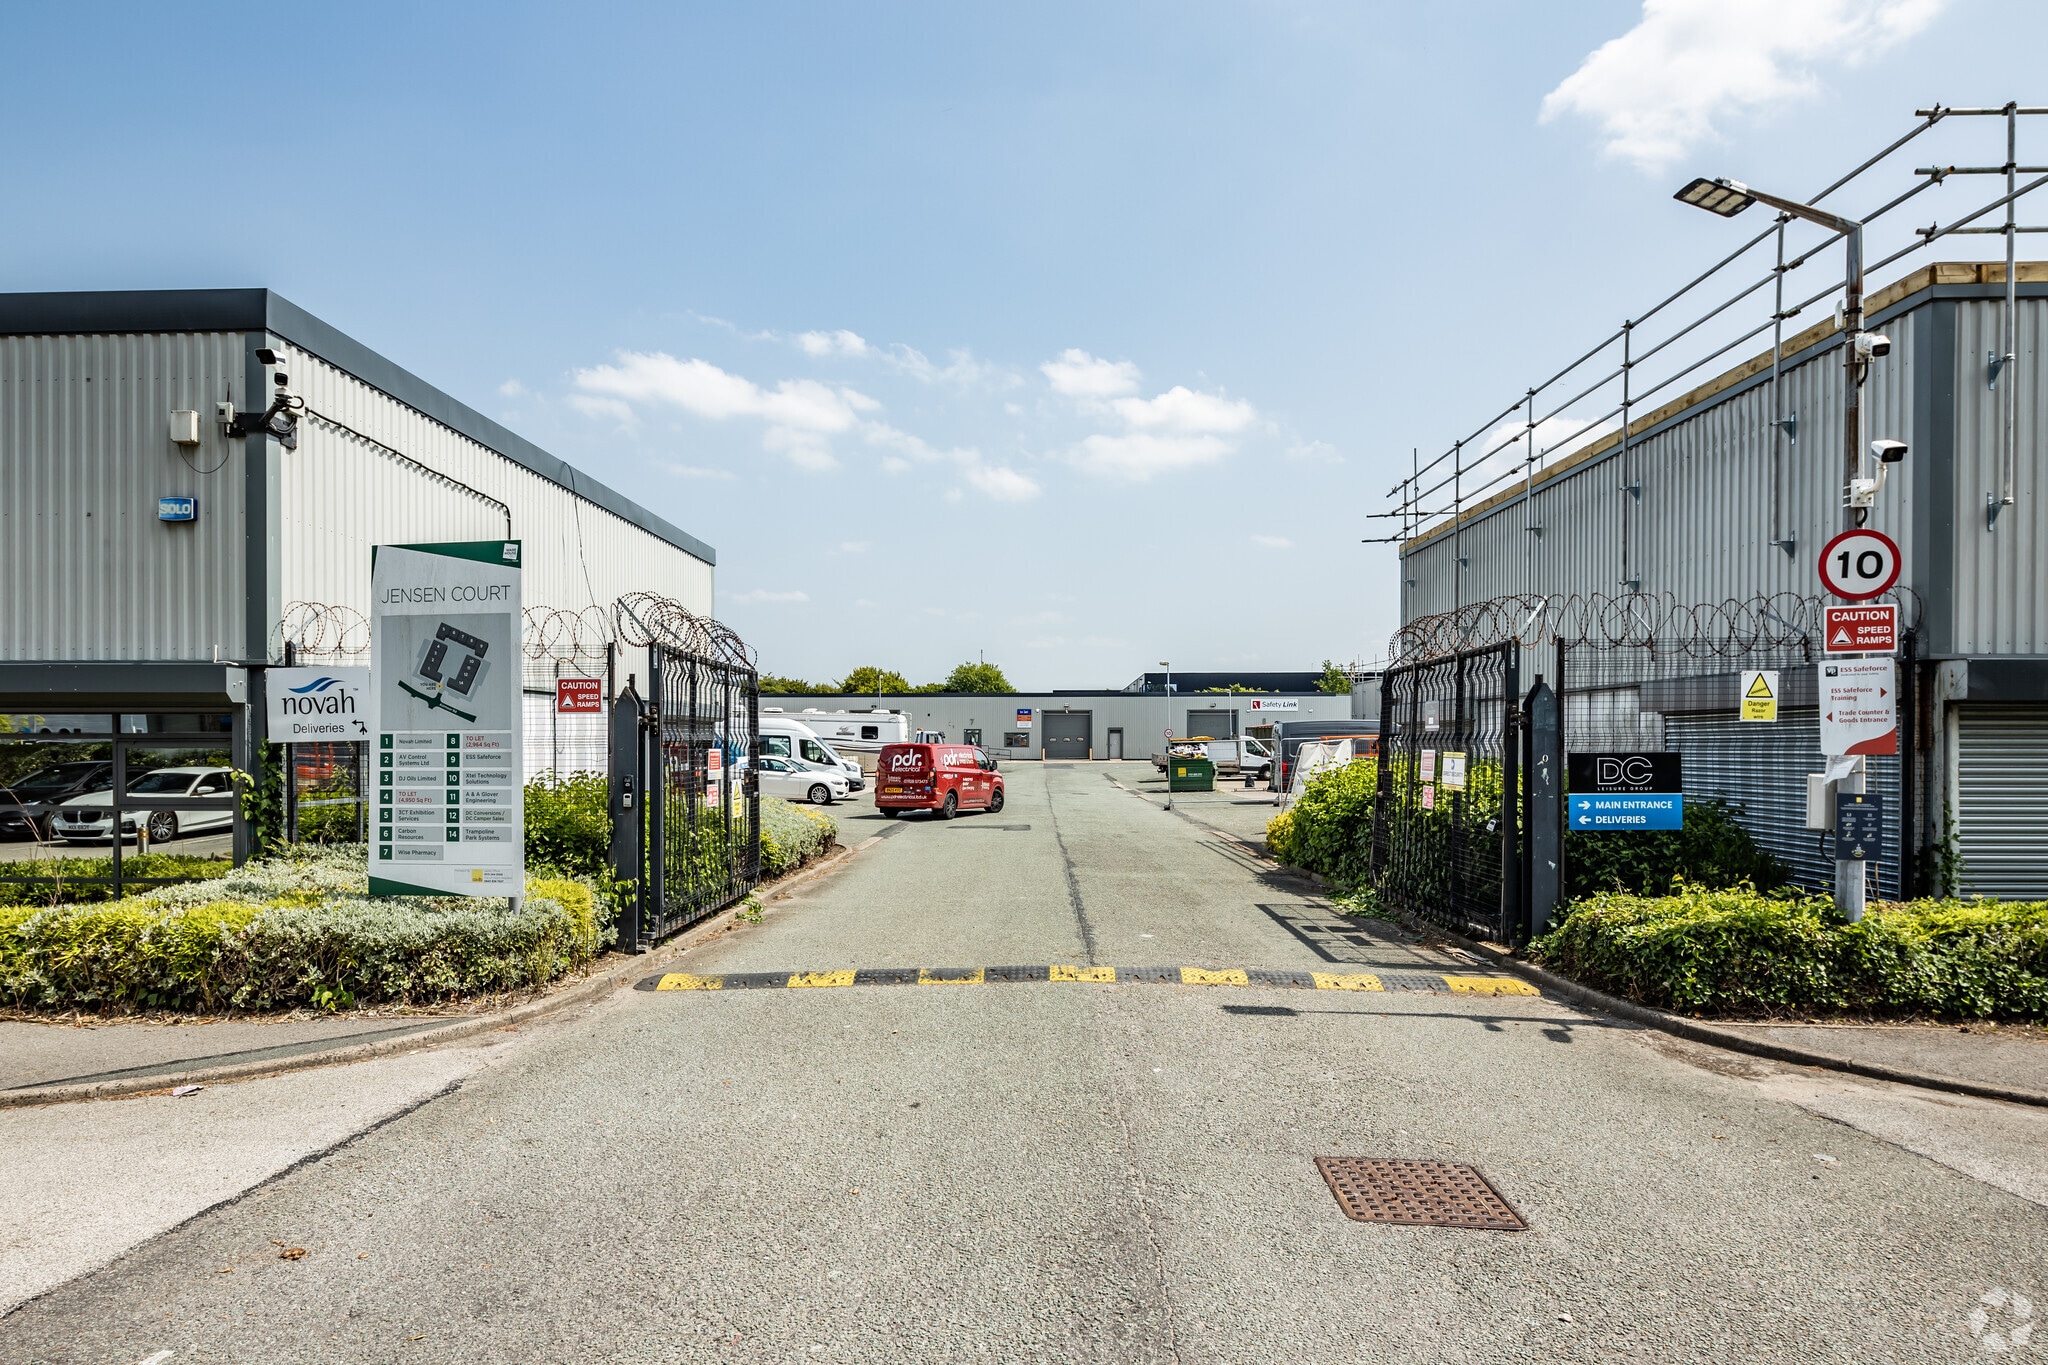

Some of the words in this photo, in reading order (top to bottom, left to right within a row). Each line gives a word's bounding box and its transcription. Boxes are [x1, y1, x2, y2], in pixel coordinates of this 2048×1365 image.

[160, 503, 190, 514] SOLO
[1837, 550, 1883, 579] 10
[381, 587, 446, 604] JENSEN
[451, 585, 511, 602] COURT
[1832, 611, 1889, 621] CAUTION
[1857, 625, 1891, 634] SPEED
[1856, 636, 1892, 645] RAMPS
[561, 682, 598, 690] CAUTION
[281, 688, 355, 715] novah
[1261, 701, 1282, 709] Safety
[293, 723, 345, 734] Deliveries
[385, 737, 389, 745] 1
[450, 737, 456, 745] 8
[384, 756, 389, 764] 2
[450, 756, 456, 764] 9
[892, 749, 922, 771] pdr.
[1597, 756, 1652, 785] DC
[384, 774, 389, 782] 3
[449, 774, 457, 782] 10
[477, 772, 508, 780] Technology
[383, 793, 389, 801] 4
[450, 793, 456, 801] 11
[1595, 801, 1621, 809] MAIN
[1622, 801, 1673, 809] ENTRANCE
[383, 811, 389, 819] 5
[449, 811, 457, 820] 12
[1595, 815, 1647, 824] DELIVERIES
[383, 830, 389, 838] 6
[449, 830, 457, 838] 14
[383, 848, 389, 857] 7
